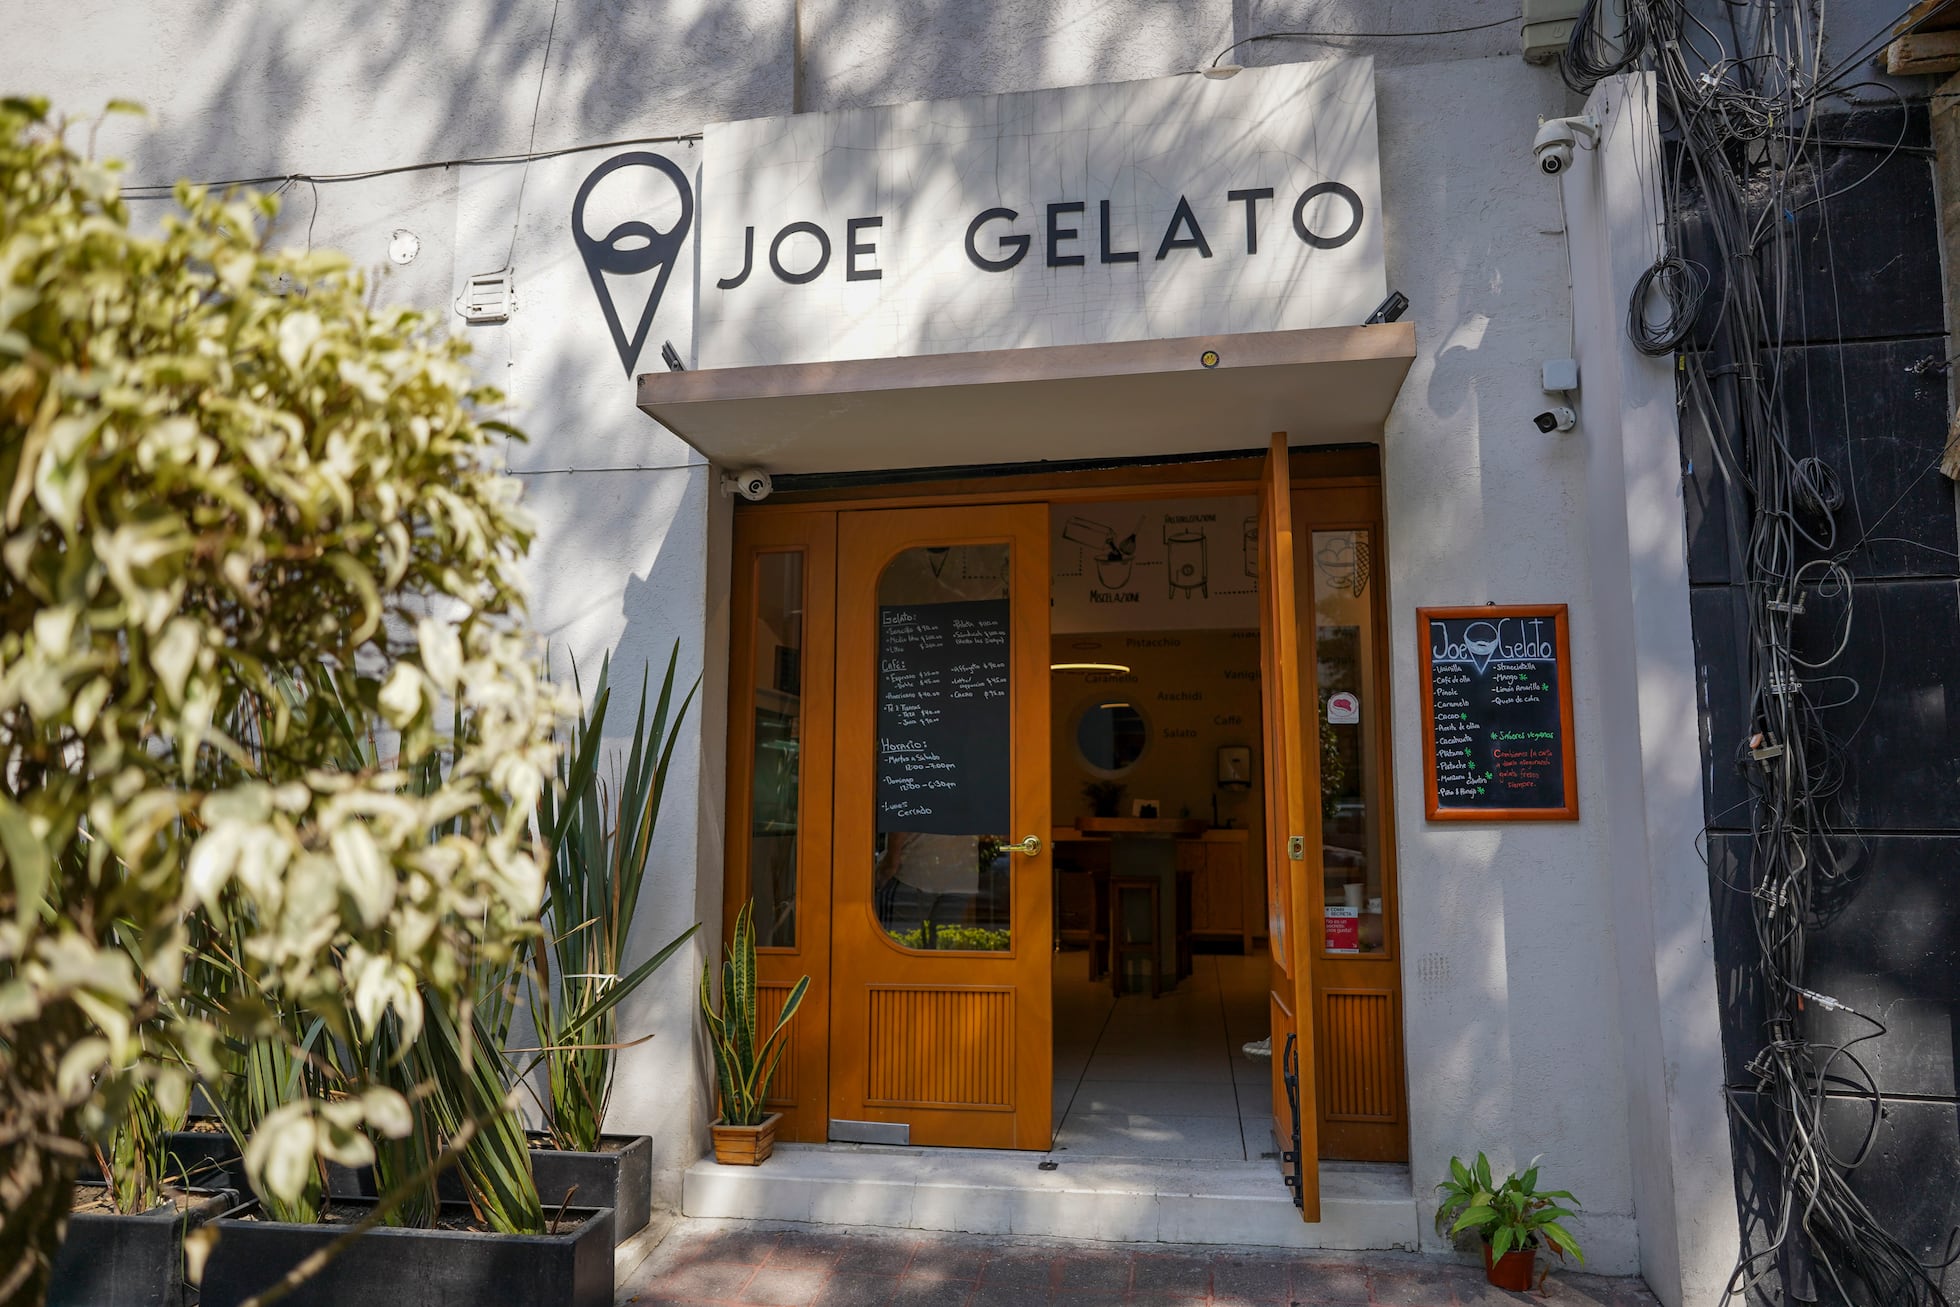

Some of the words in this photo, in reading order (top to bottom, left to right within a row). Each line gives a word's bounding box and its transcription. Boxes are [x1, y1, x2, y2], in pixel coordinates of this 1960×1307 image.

[716, 216, 883, 290] JOE
[964, 181, 1364, 273] GELATO
[1126, 638, 1180, 648] Pistacchio
[1431, 622, 1468, 660] Joe
[1498, 618, 1552, 660] Gelato
[1084, 673, 1138, 684] Caramello
[1452, 675, 1459, 683] de
[1496, 673, 1518, 685] Mango
[1436, 688, 1458, 696] Pinole
[1437, 698, 1469, 708] Caramelo
[1515, 695, 1523, 703] de
[1162, 728, 1197, 738] Salato
[1499, 731, 1525, 740] Sabores
[881, 738, 928, 752] Horario:
[889, 754, 909, 763] Martes
[1440, 760, 1467, 770] Pistache
[886, 776, 914, 786] Domingo
[900, 782, 920, 791] 12:00
[898, 806, 932, 817] Cerrado
